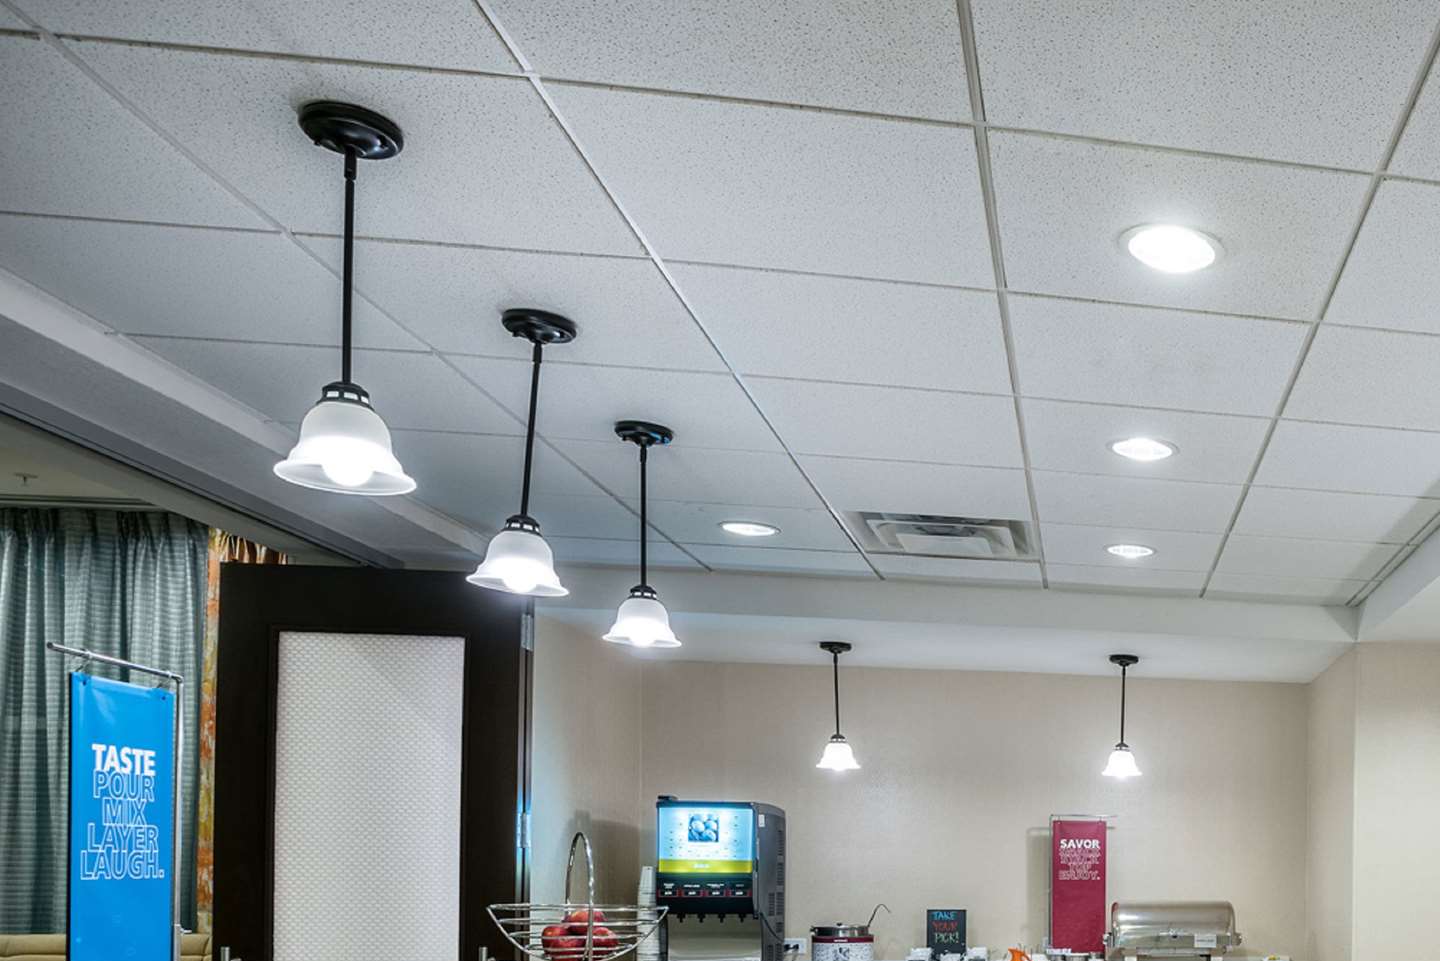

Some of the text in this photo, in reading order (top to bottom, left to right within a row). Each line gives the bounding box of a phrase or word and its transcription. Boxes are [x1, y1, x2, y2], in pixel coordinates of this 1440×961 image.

[92, 744, 156, 776] TASTE
[93, 770, 155, 802] POUR
[102, 797, 147, 827] MIX
[88, 823, 158, 852] LAYER
[1060, 839, 1100, 849] SAVOR
[80, 850, 165, 880] LAUGH.
[931, 911, 958, 920] TAKE
